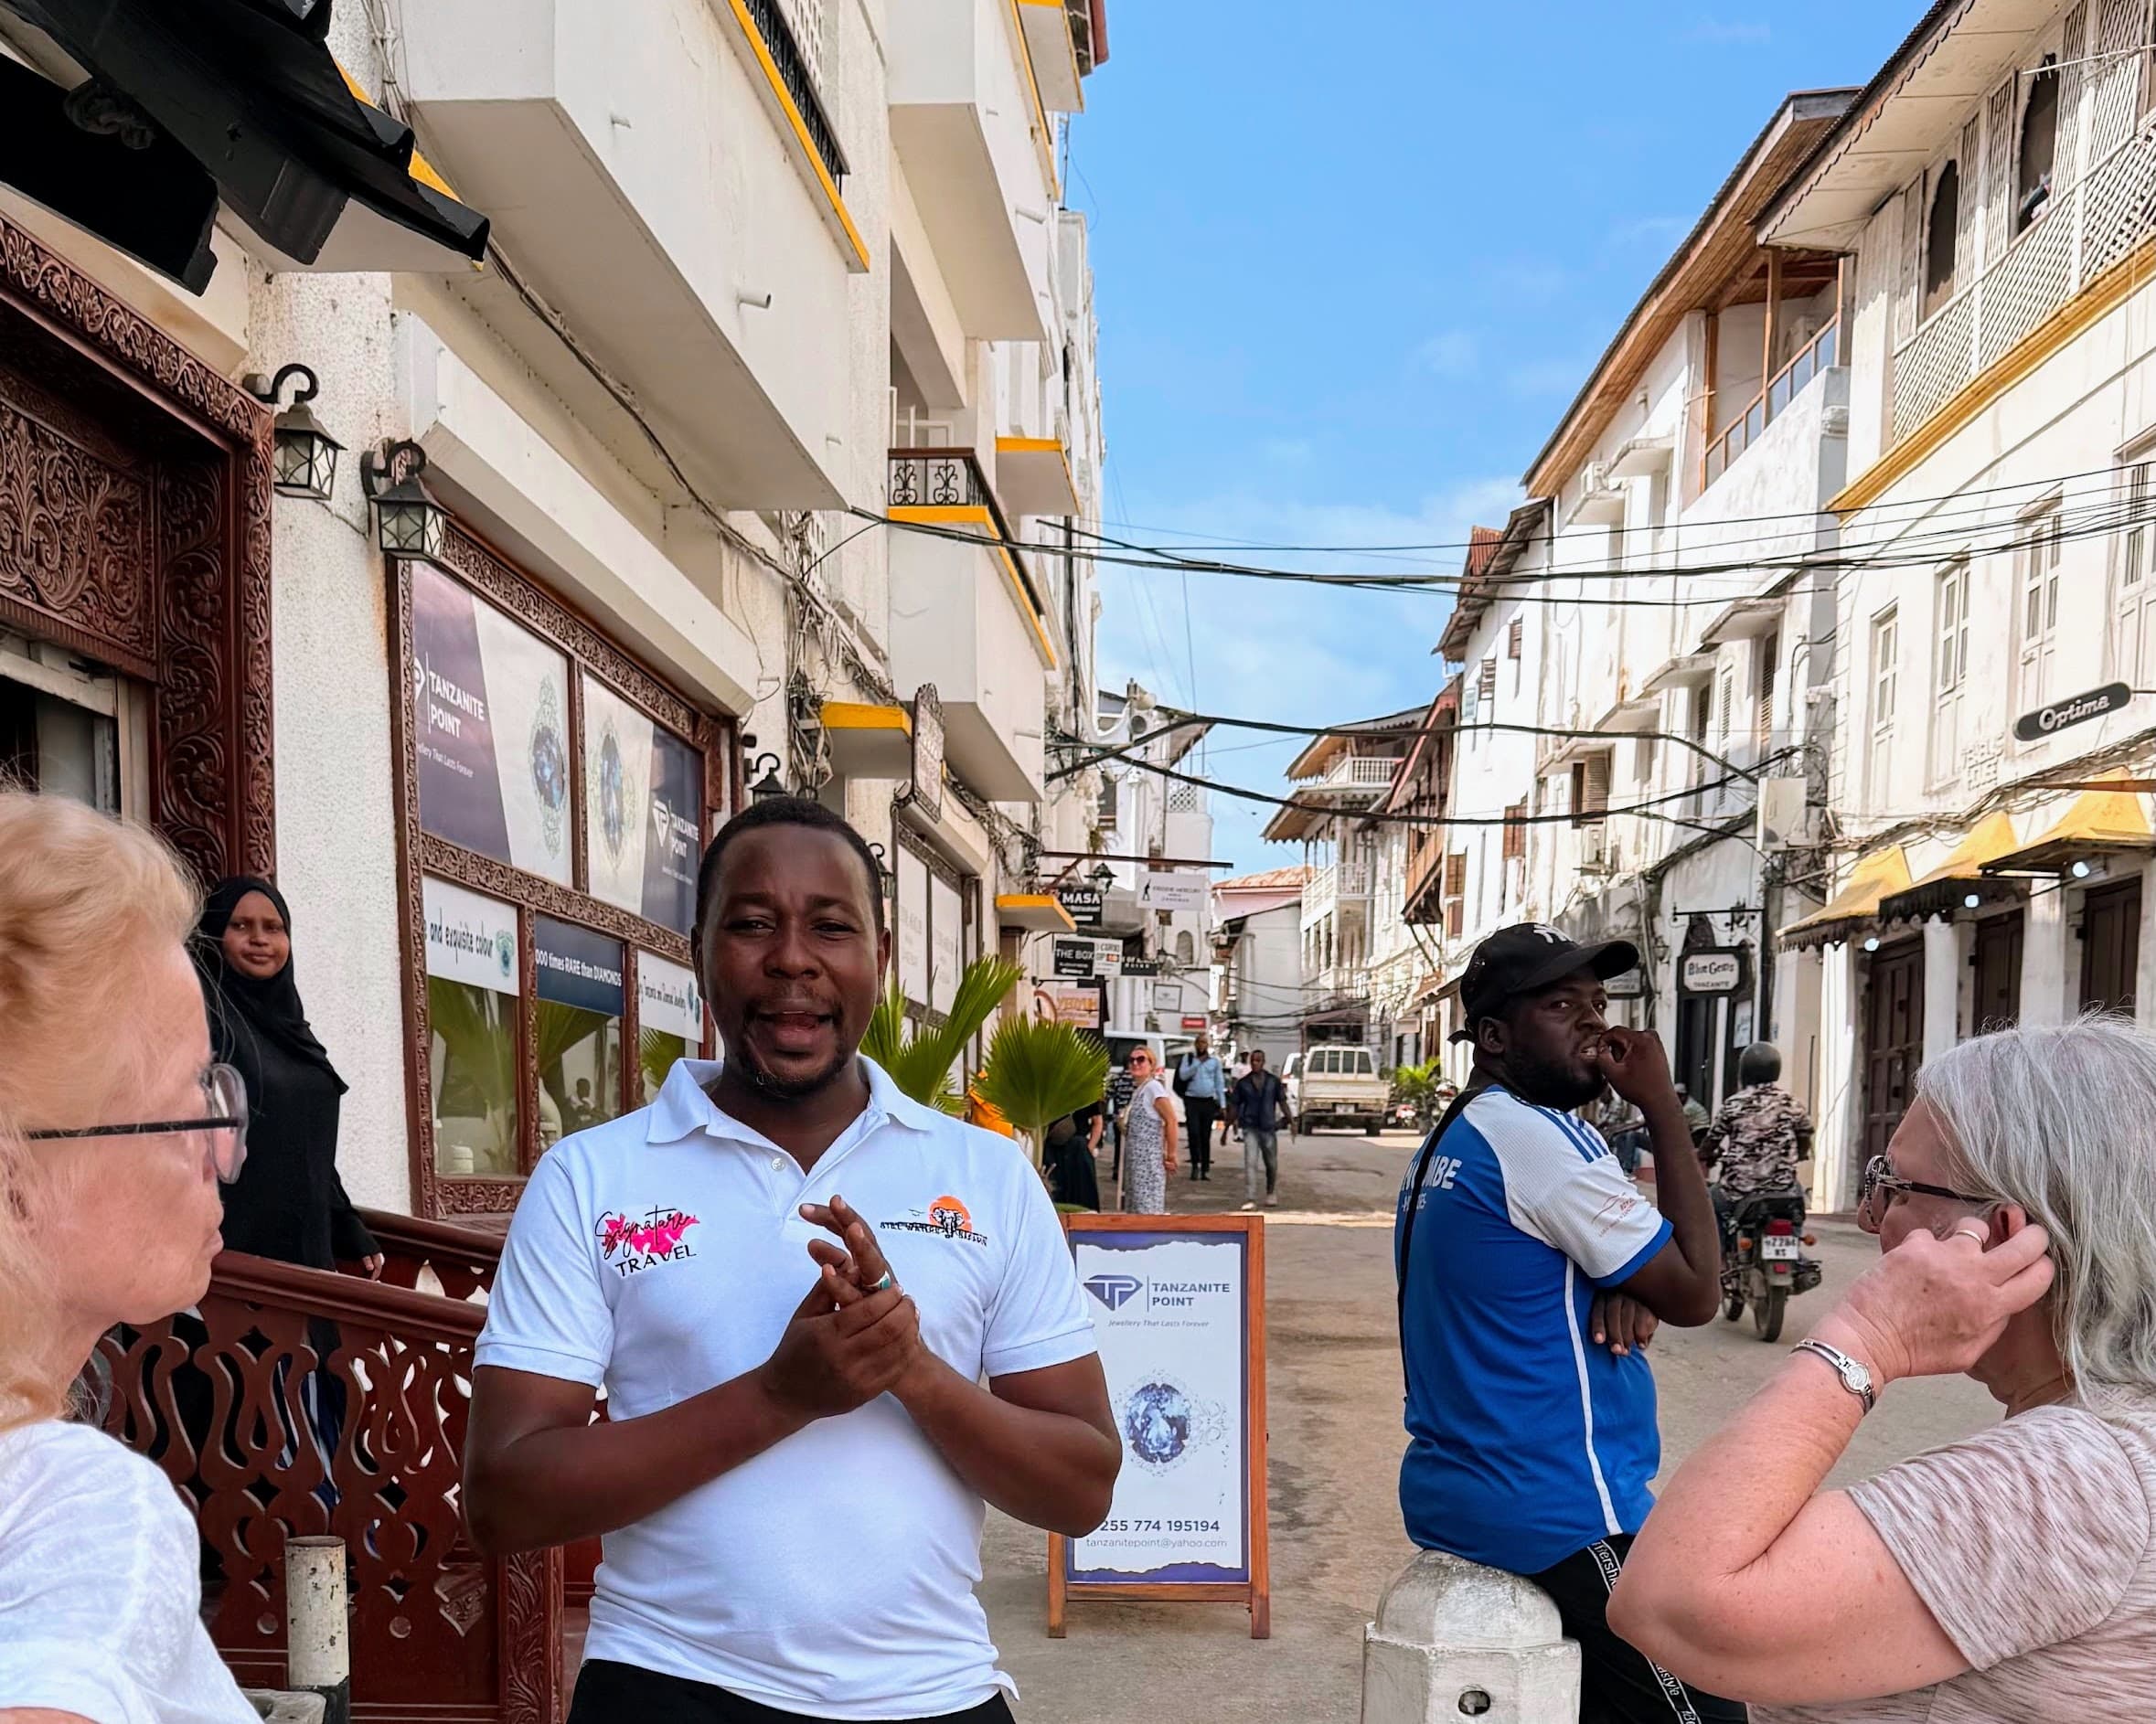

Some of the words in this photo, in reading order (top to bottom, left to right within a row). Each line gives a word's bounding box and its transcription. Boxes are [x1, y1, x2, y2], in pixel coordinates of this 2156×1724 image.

[429, 670, 485, 721] TANZANITE
[2038, 696, 2110, 730] Optima
[430, 704, 462, 739] POINT
[1056, 948, 1073, 959] THE
[1075, 949, 1094, 960] BOX
[565, 956, 581, 975] RARE
[593, 964, 622, 987] DIAMONDS
[614, 1244, 697, 1277] TRAVEL
[1151, 1282, 1230, 1293] TANZANITE
[1151, 1296, 1194, 1307] POINT
[1108, 1319, 1141, 1328] Jewellery
[1142, 1319, 1160, 1327] That
[1160, 1319, 1180, 1327] Lasts
[1181, 1319, 1210, 1327] Forever
[1134, 1520, 1161, 1532] 774
[1167, 1520, 1221, 1532] 195194
[1086, 1538, 1228, 1548] tanzanitepoint@yahoo.com
